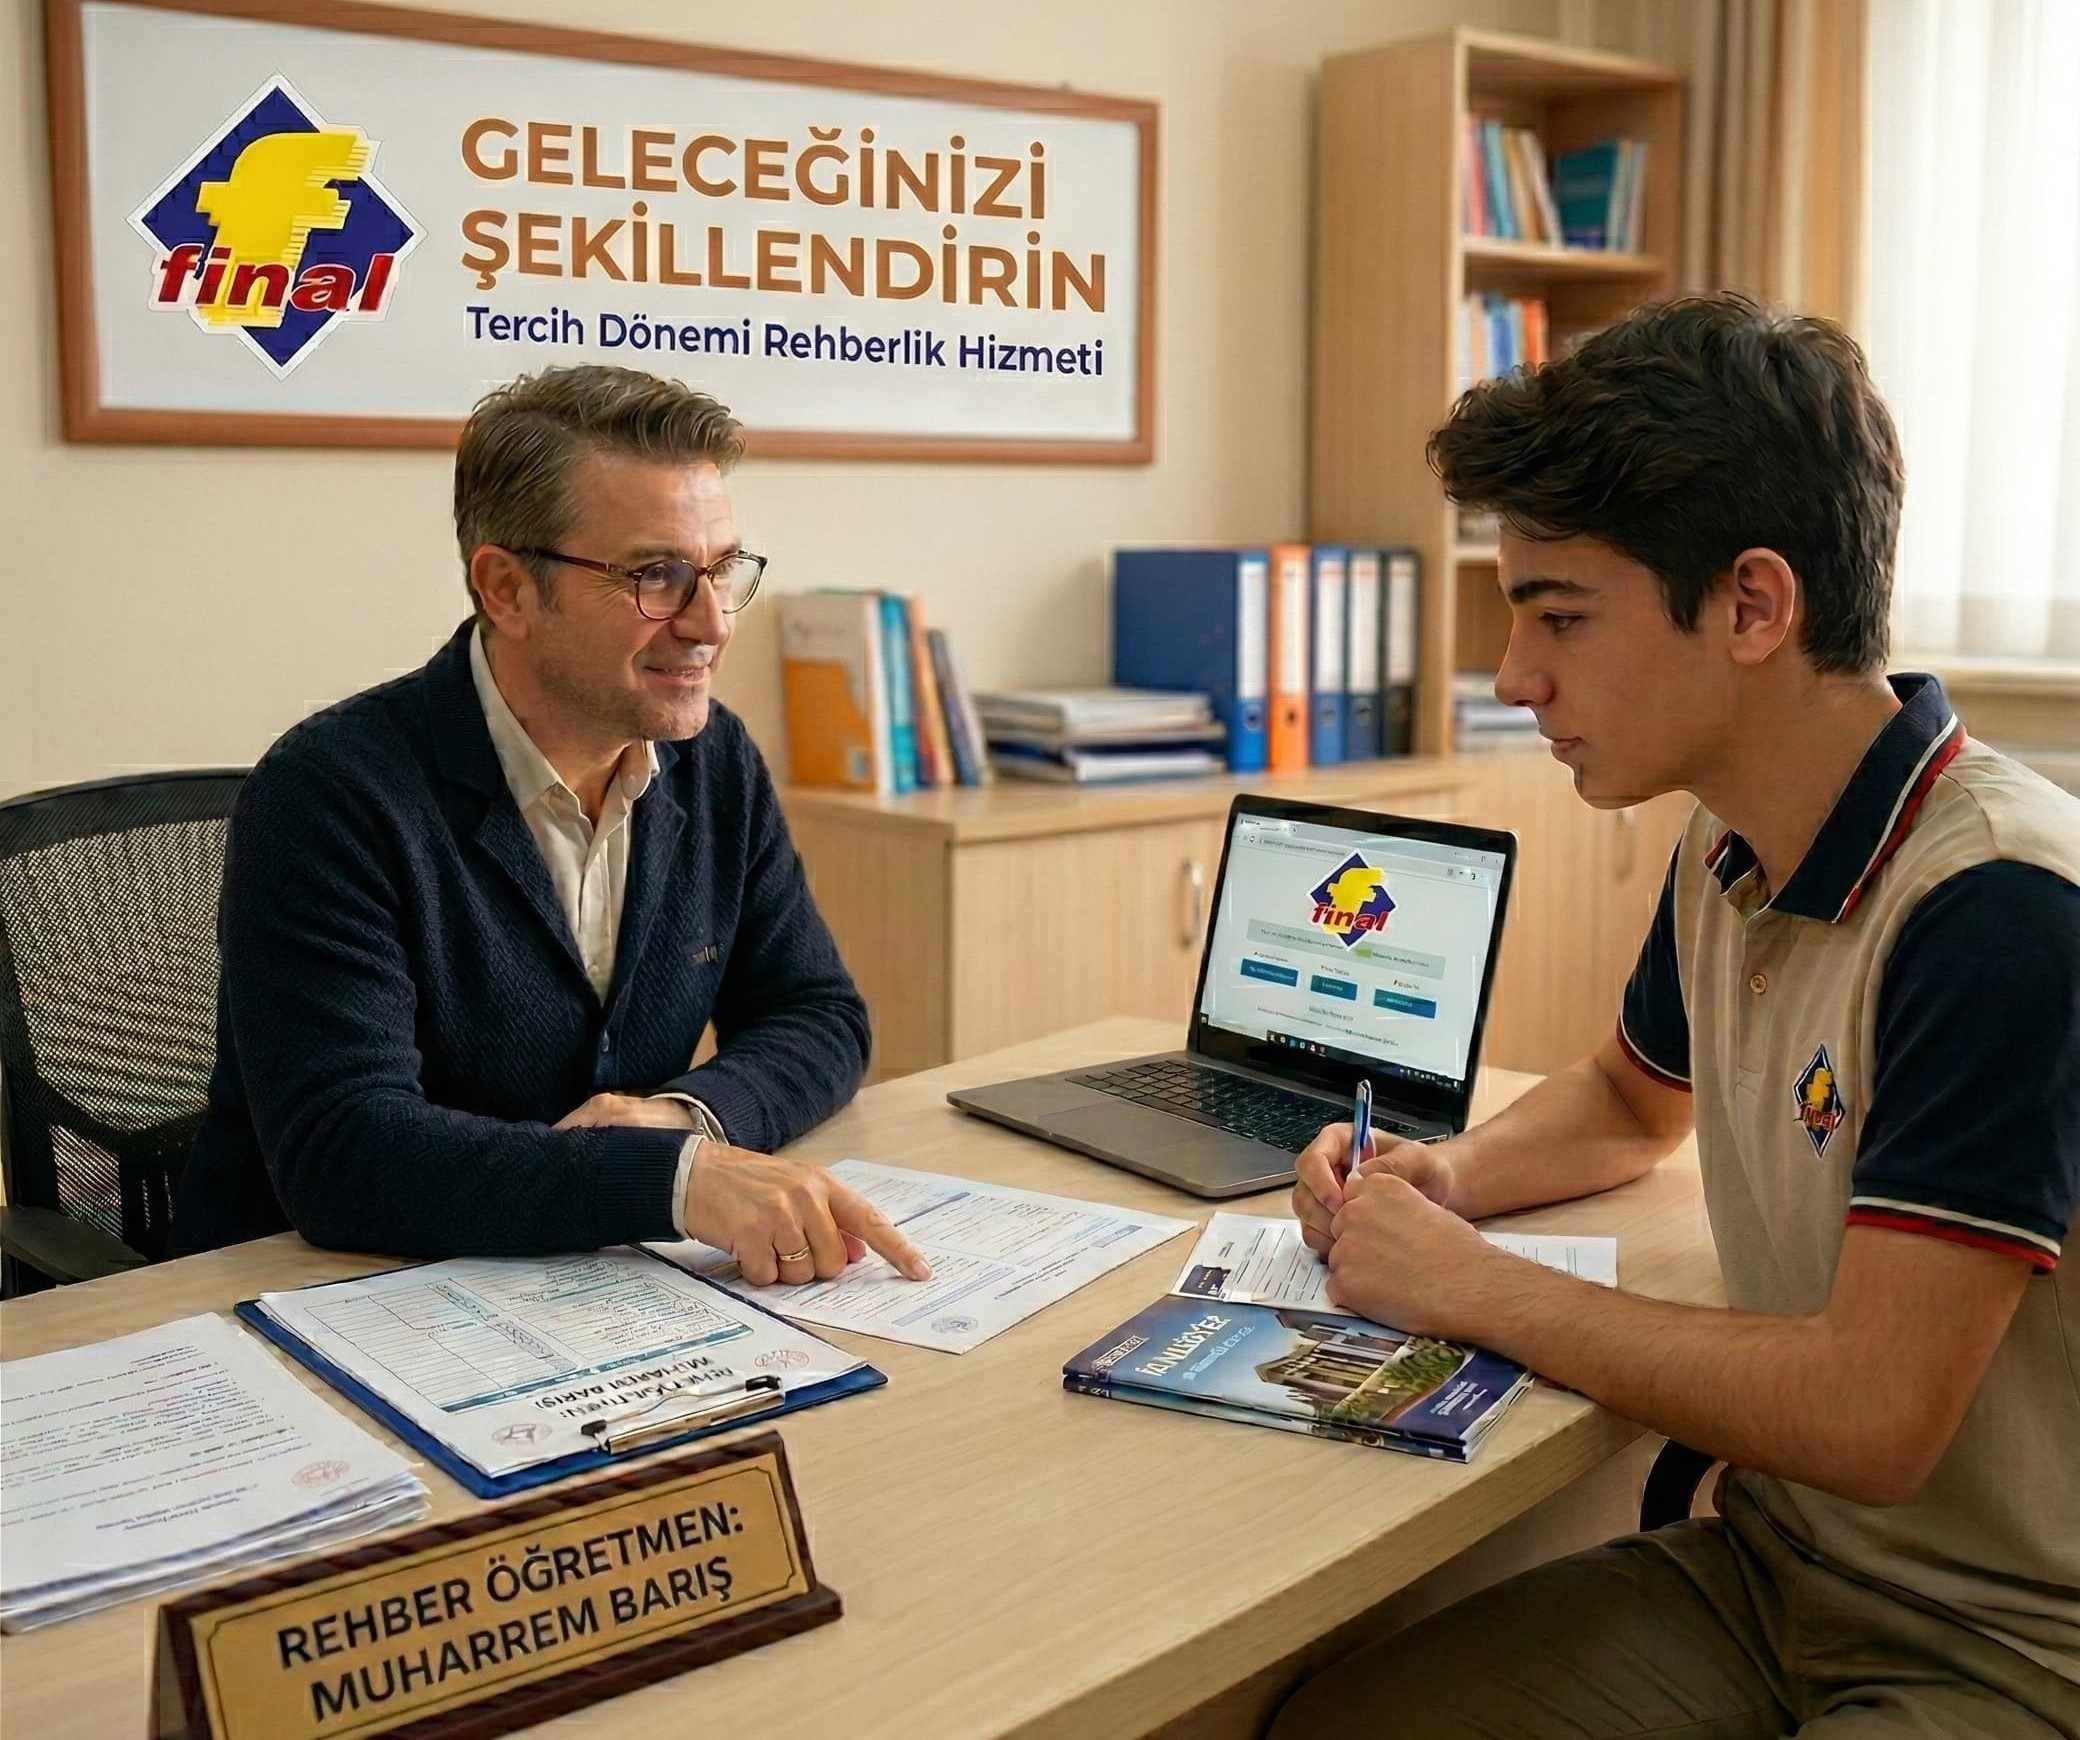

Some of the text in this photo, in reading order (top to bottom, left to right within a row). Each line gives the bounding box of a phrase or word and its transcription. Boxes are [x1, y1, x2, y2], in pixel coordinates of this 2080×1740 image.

[462, 116, 1047, 221] GELECEĞİNİZİ
[157, 245, 395, 312] final
[461, 201, 1106, 314] ŞEKİLLENDİRİN
[466, 306, 1104, 376] Tercih Dönemi Rehberlik Hizmeti
[1311, 904, 1391, 932] final
[277, 1502, 744, 1669] REHBER ÖĞRETMEN:
[309, 1555, 734, 1723] MUHARREM BARIŞ
